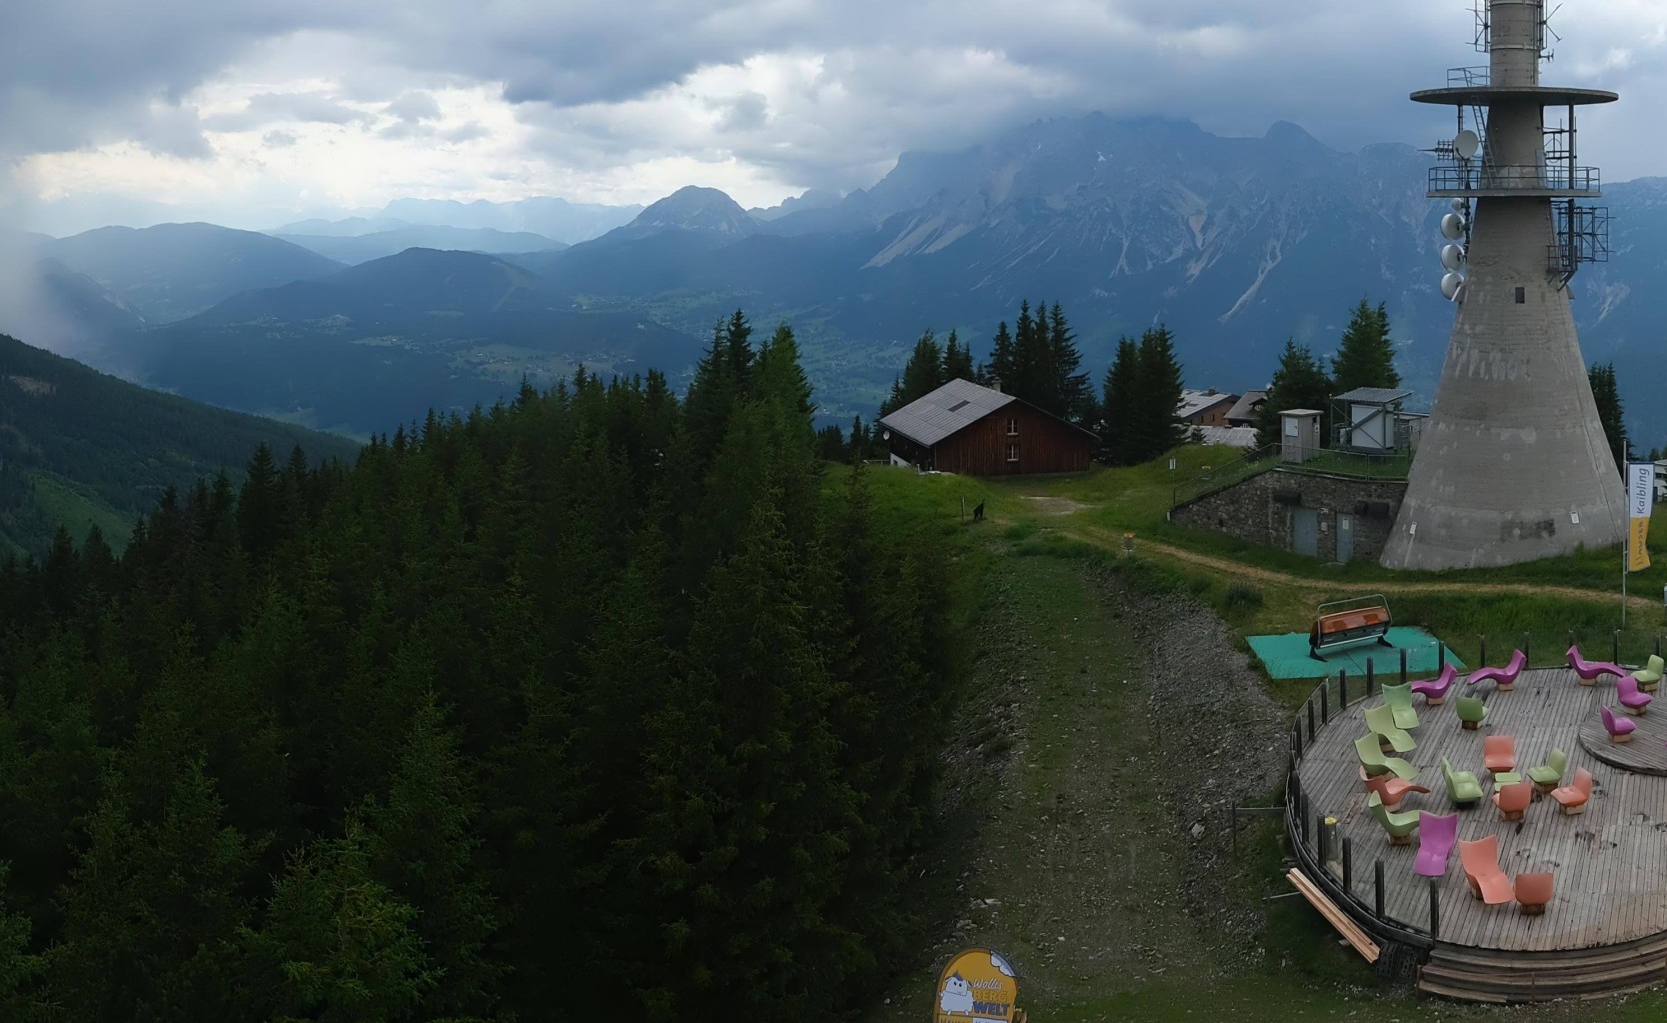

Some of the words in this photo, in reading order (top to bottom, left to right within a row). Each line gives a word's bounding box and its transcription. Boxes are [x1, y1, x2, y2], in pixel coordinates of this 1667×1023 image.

[1637, 468, 1650, 514] Kaibling
[973, 989, 1008, 1001] BERG
[972, 1001, 1010, 1016] WELT
